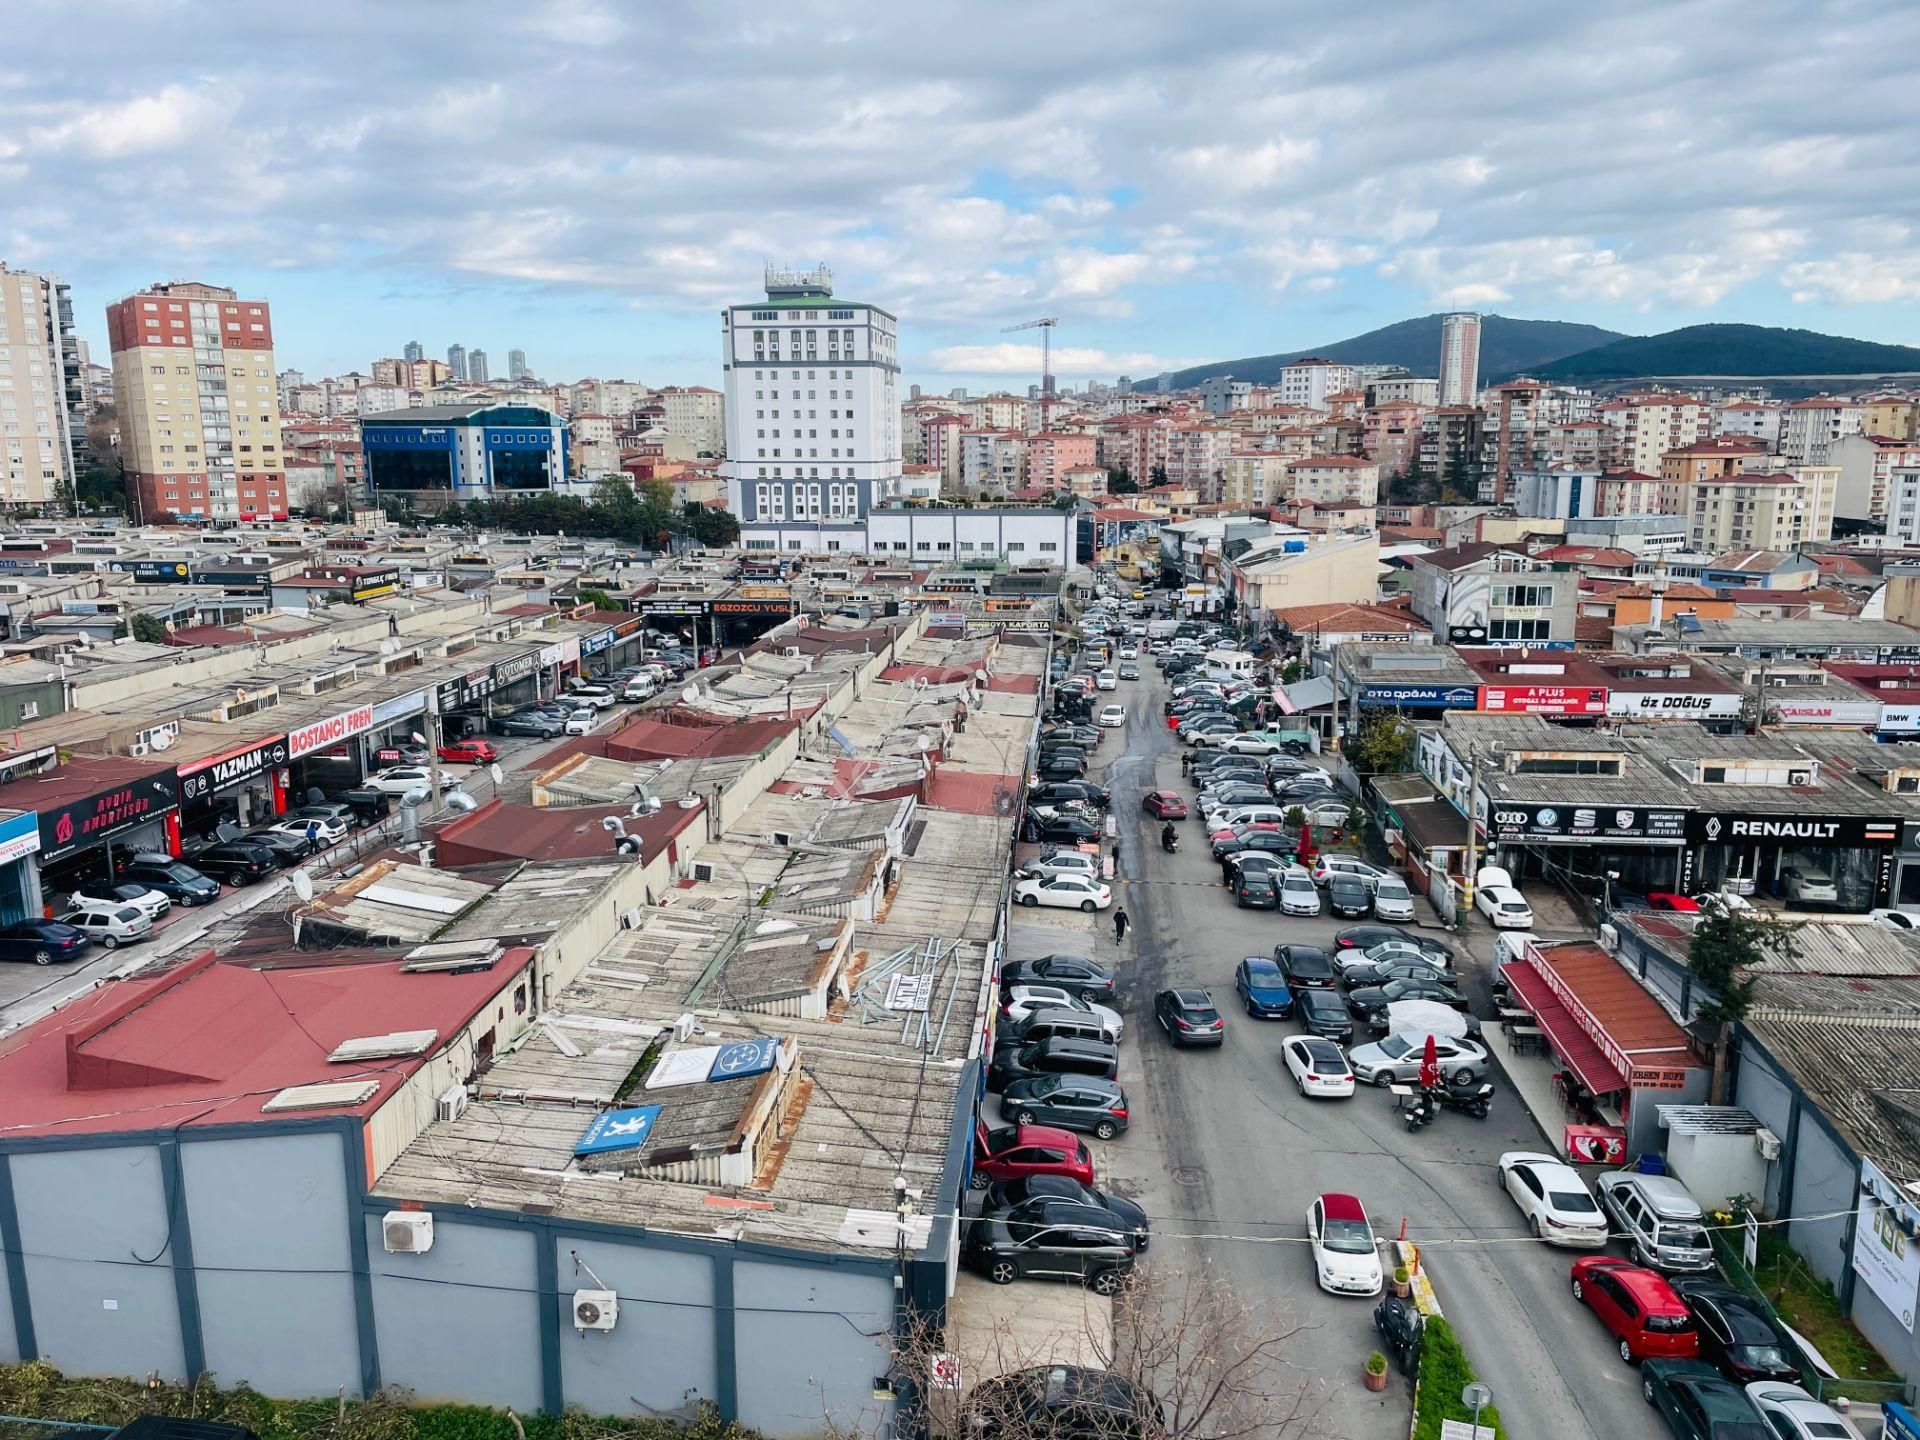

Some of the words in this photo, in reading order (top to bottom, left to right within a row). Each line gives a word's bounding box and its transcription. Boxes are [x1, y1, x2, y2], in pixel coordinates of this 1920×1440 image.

[713, 603, 761, 612] EGZOZCU
[1009, 621, 1049, 629] KAPORTA
[504, 656, 533, 675] OTOMER
[1367, 690, 1393, 698] OTO
[1529, 688, 1536, 696] A
[1539, 688, 1564, 696] PLUS
[1662, 696, 1712, 710] DOĞUŞ
[1887, 714, 1908, 722] BMW
[291, 720, 344, 753] BOSTANCI
[348, 708, 372, 732] FREN
[212, 749, 262, 782] YAZMAN
[1732, 821, 1840, 838] RENAULT
[12, 844, 37, 858] VOLVO
[1684, 850, 1692, 893] RENAULT
[1633, 1071, 1660, 1079] ERSEN
[583, 1115, 609, 1145] PEUGEOT
